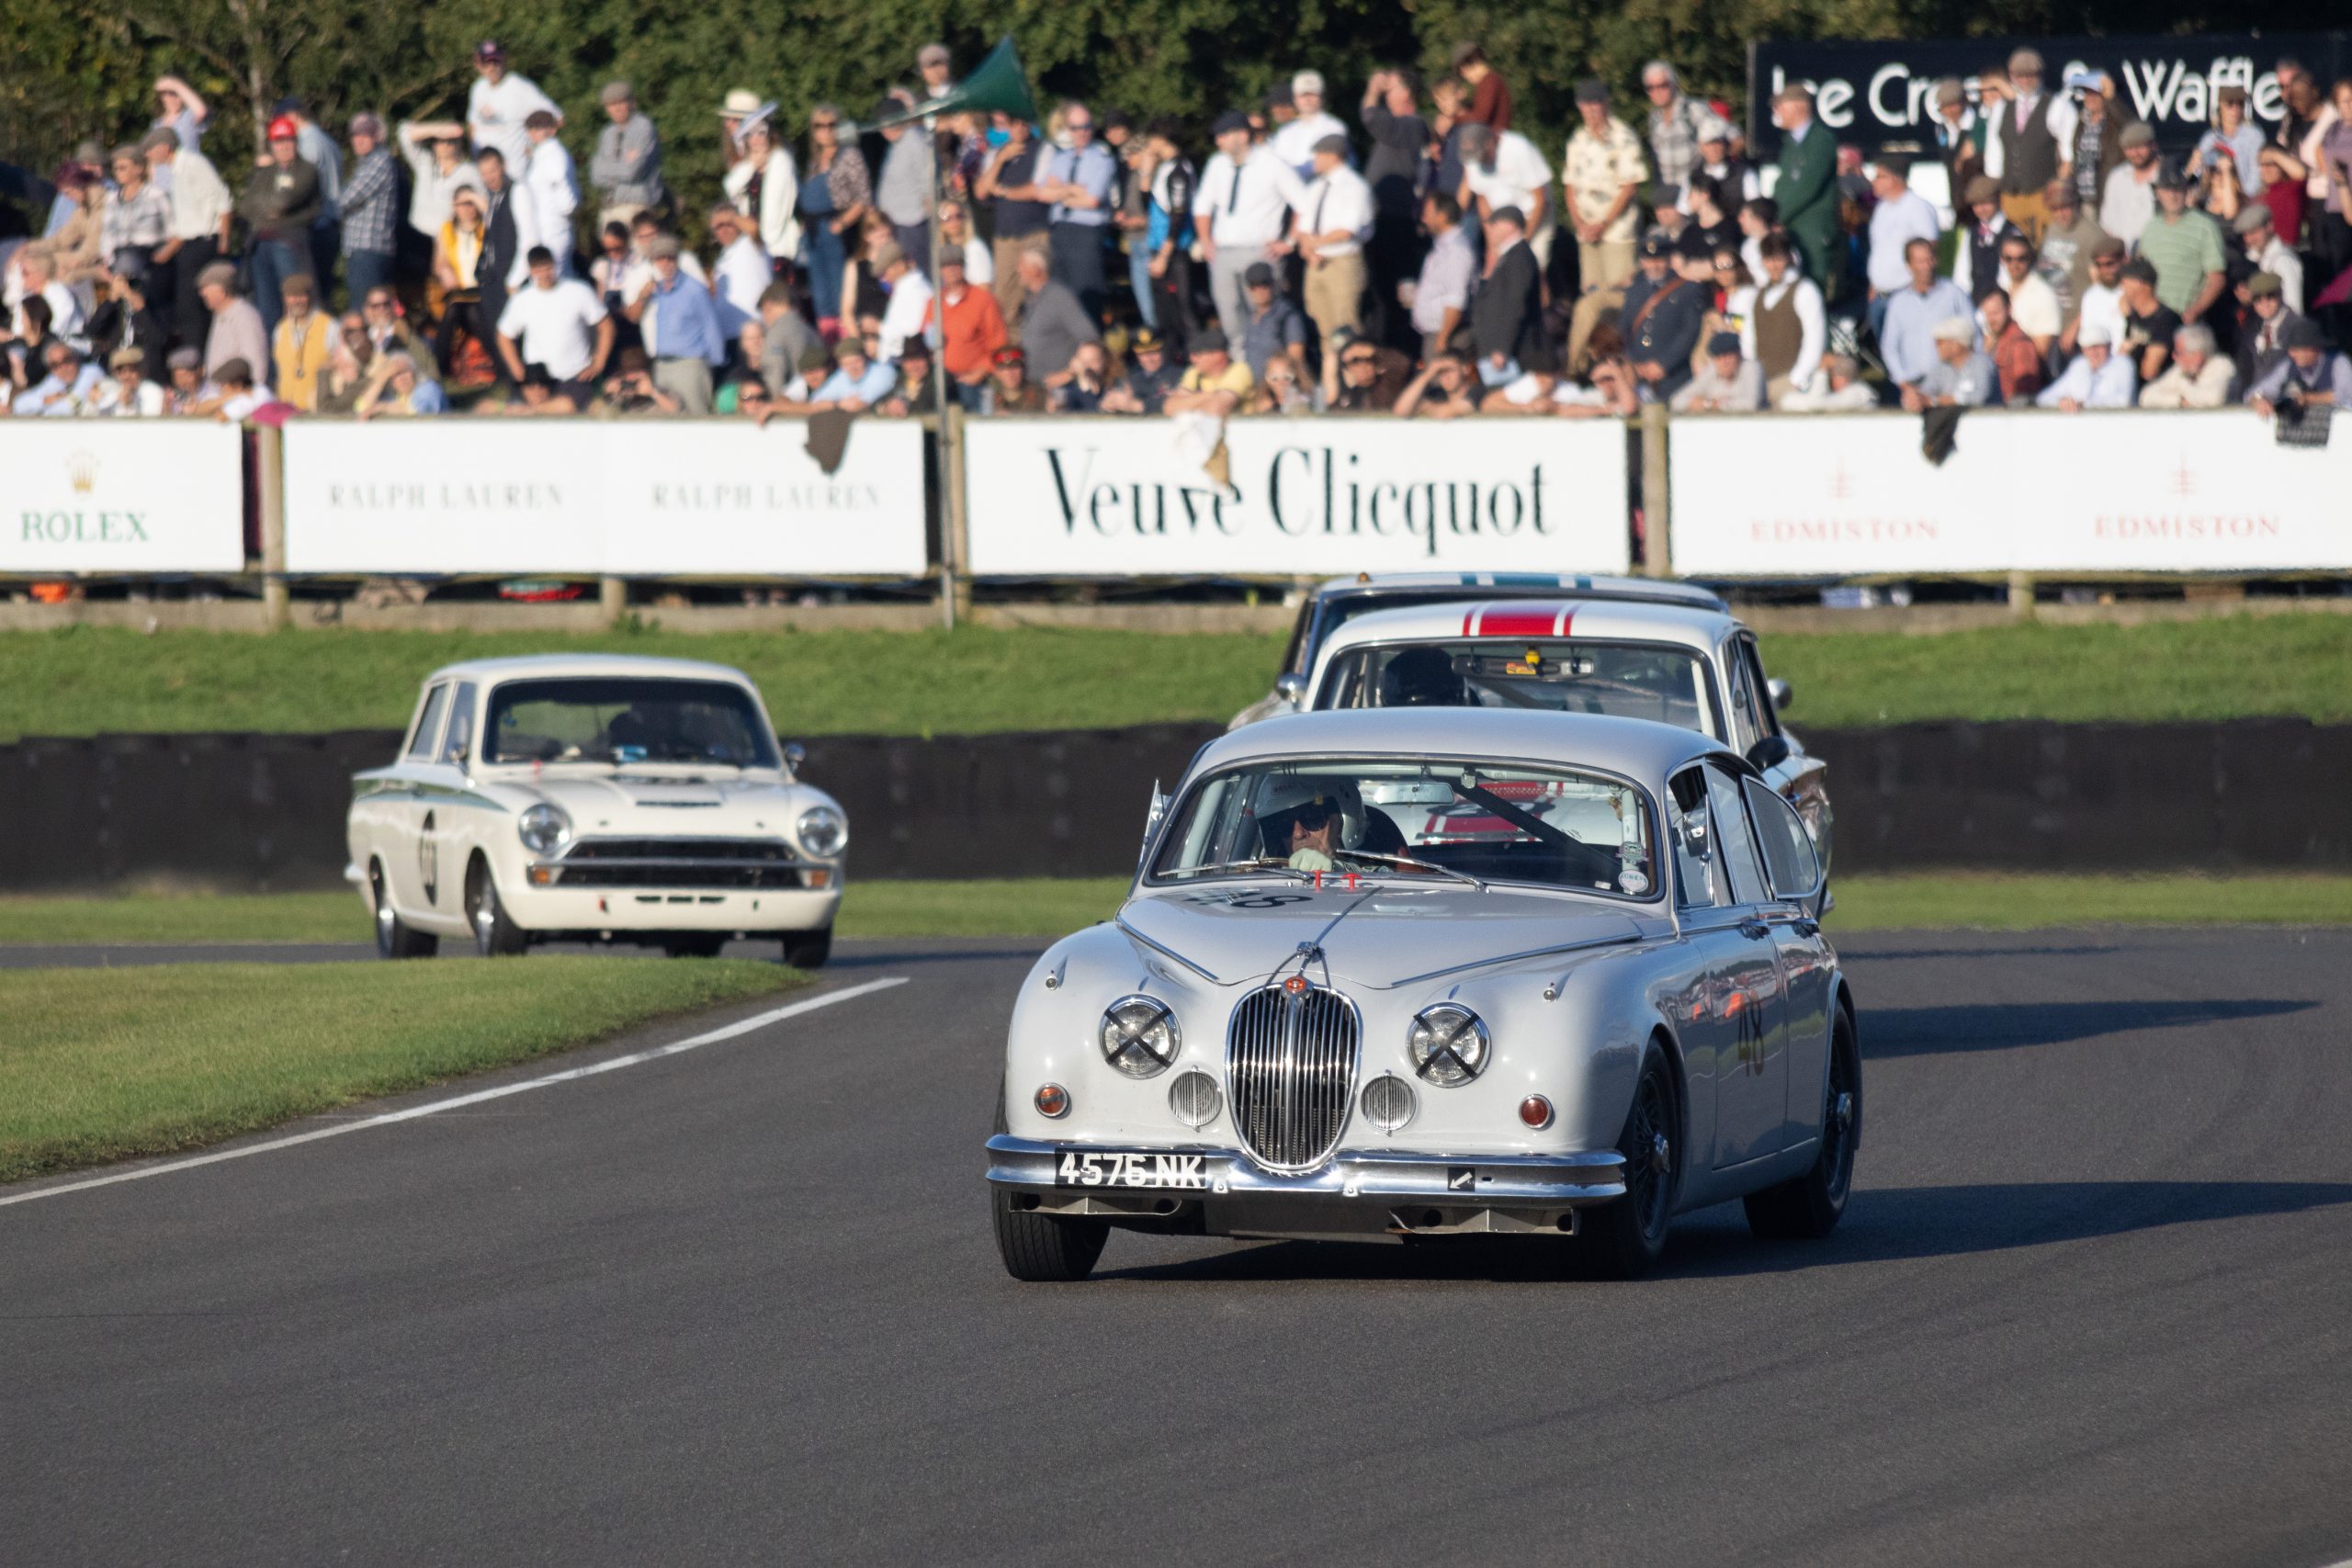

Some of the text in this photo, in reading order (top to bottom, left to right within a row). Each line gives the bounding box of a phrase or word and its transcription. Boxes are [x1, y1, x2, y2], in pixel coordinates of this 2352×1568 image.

[1771, 64, 1854, 128] Ie
[330, 483, 563, 508] RALPH LAUREN
[652, 483, 879, 509] RALPH LAUREN
[1042, 446, 1555, 558] Veuve Clicquot
[21, 513, 149, 542] ROLEX
[1751, 520, 1938, 542] EDMISTON
[2095, 515, 2278, 539] EDMISTON
[1737, 989, 1765, 1077] 48
[1059, 1153, 1202, 1188] 4576 NK
